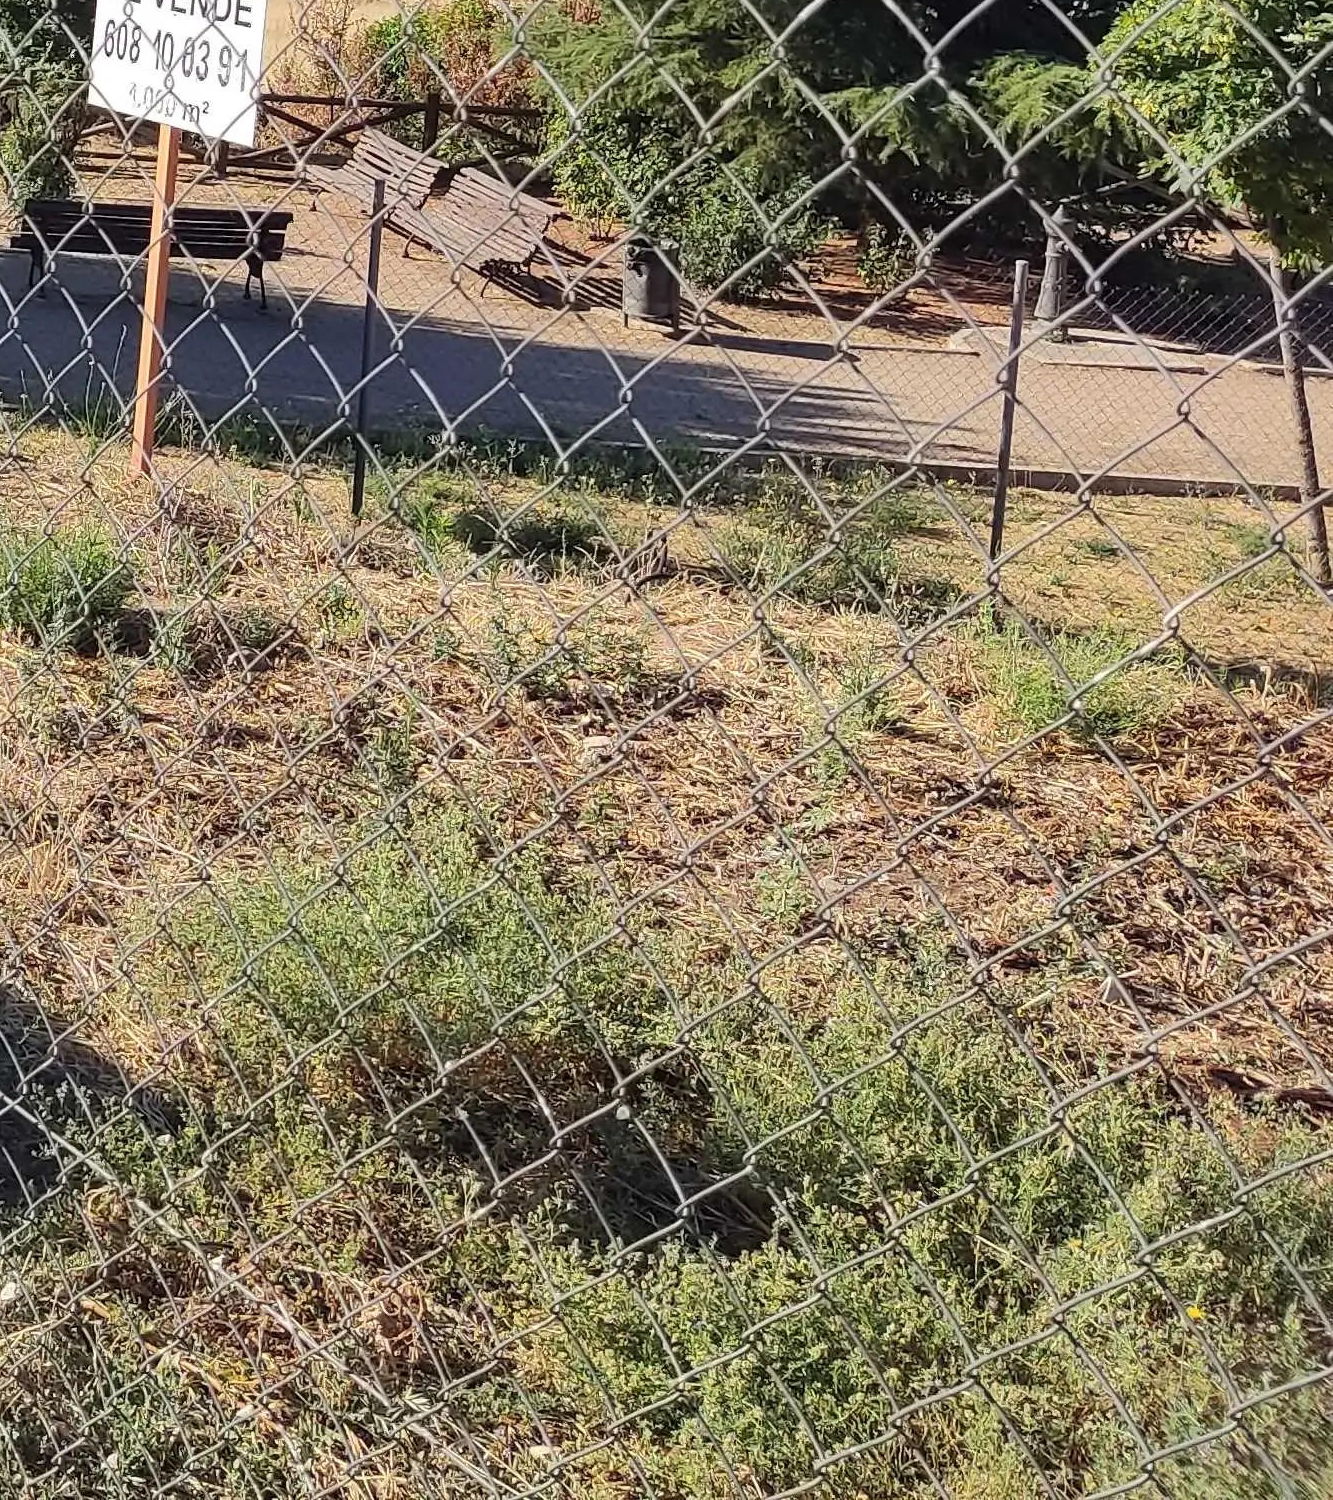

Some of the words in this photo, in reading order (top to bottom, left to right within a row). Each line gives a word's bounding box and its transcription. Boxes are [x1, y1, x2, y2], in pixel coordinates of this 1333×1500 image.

[104, 19, 141, 63] 608
[153, 30, 174, 73] 10
[218, 45, 247, 92] 91
